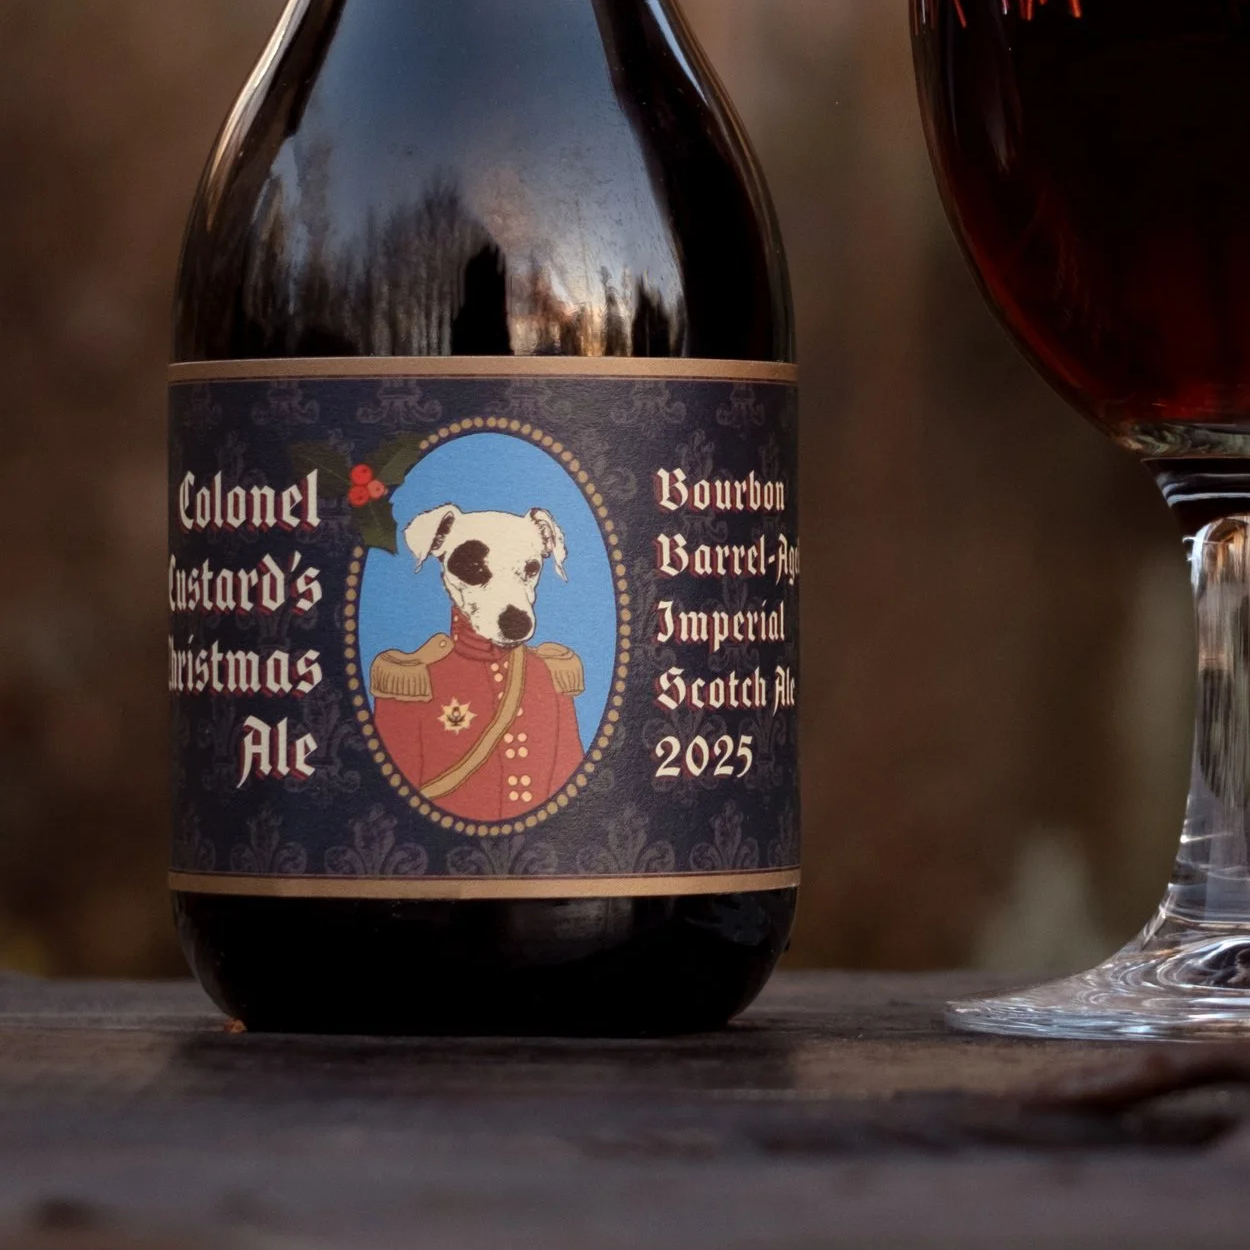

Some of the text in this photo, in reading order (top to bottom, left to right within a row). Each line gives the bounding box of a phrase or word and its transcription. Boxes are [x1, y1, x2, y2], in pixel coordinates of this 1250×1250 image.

[179, 468, 321, 530] Colonel
[656, 467, 785, 512] Bourbon
[656, 600, 785, 653] Imperial
[656, 666, 796, 716] Scotch Ale
[236, 715, 318, 789] Ale
[655, 735, 753, 777] 2025
